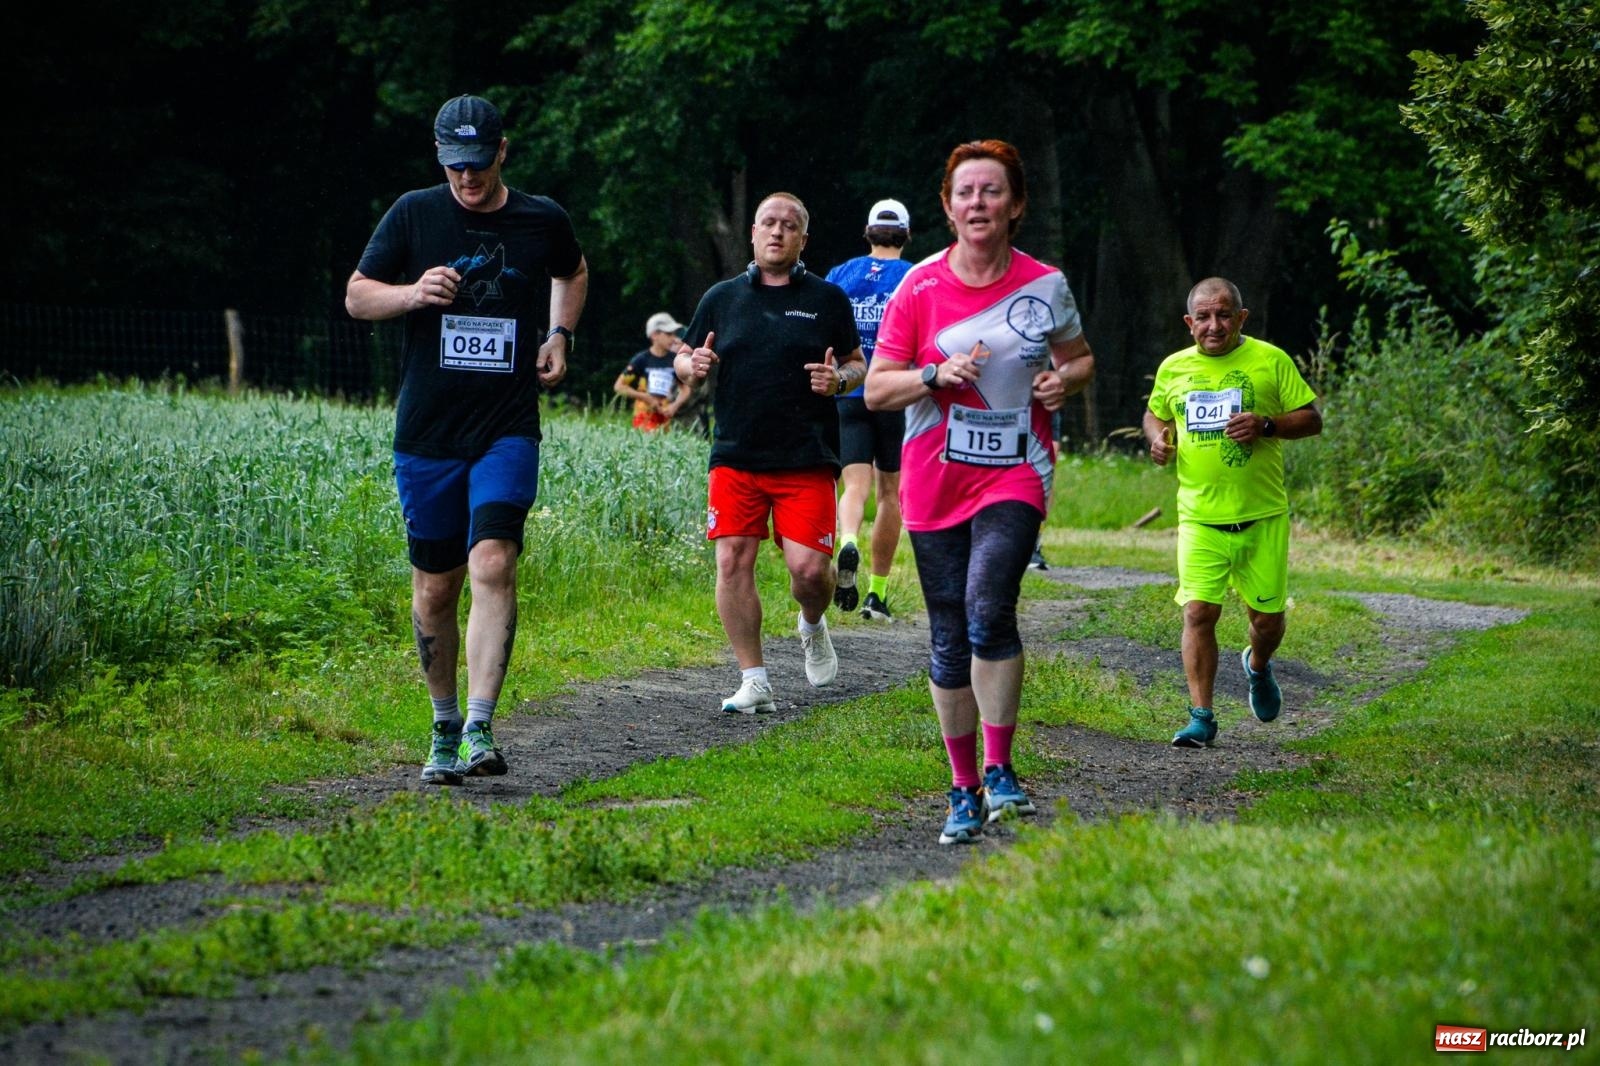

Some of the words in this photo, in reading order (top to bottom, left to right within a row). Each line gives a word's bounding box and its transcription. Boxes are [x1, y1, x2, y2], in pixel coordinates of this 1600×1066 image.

[855, 306, 883, 321] LESI
[453, 336, 497, 356] 084
[1195, 404, 1223, 420] 041
[967, 430, 1002, 452] 115
